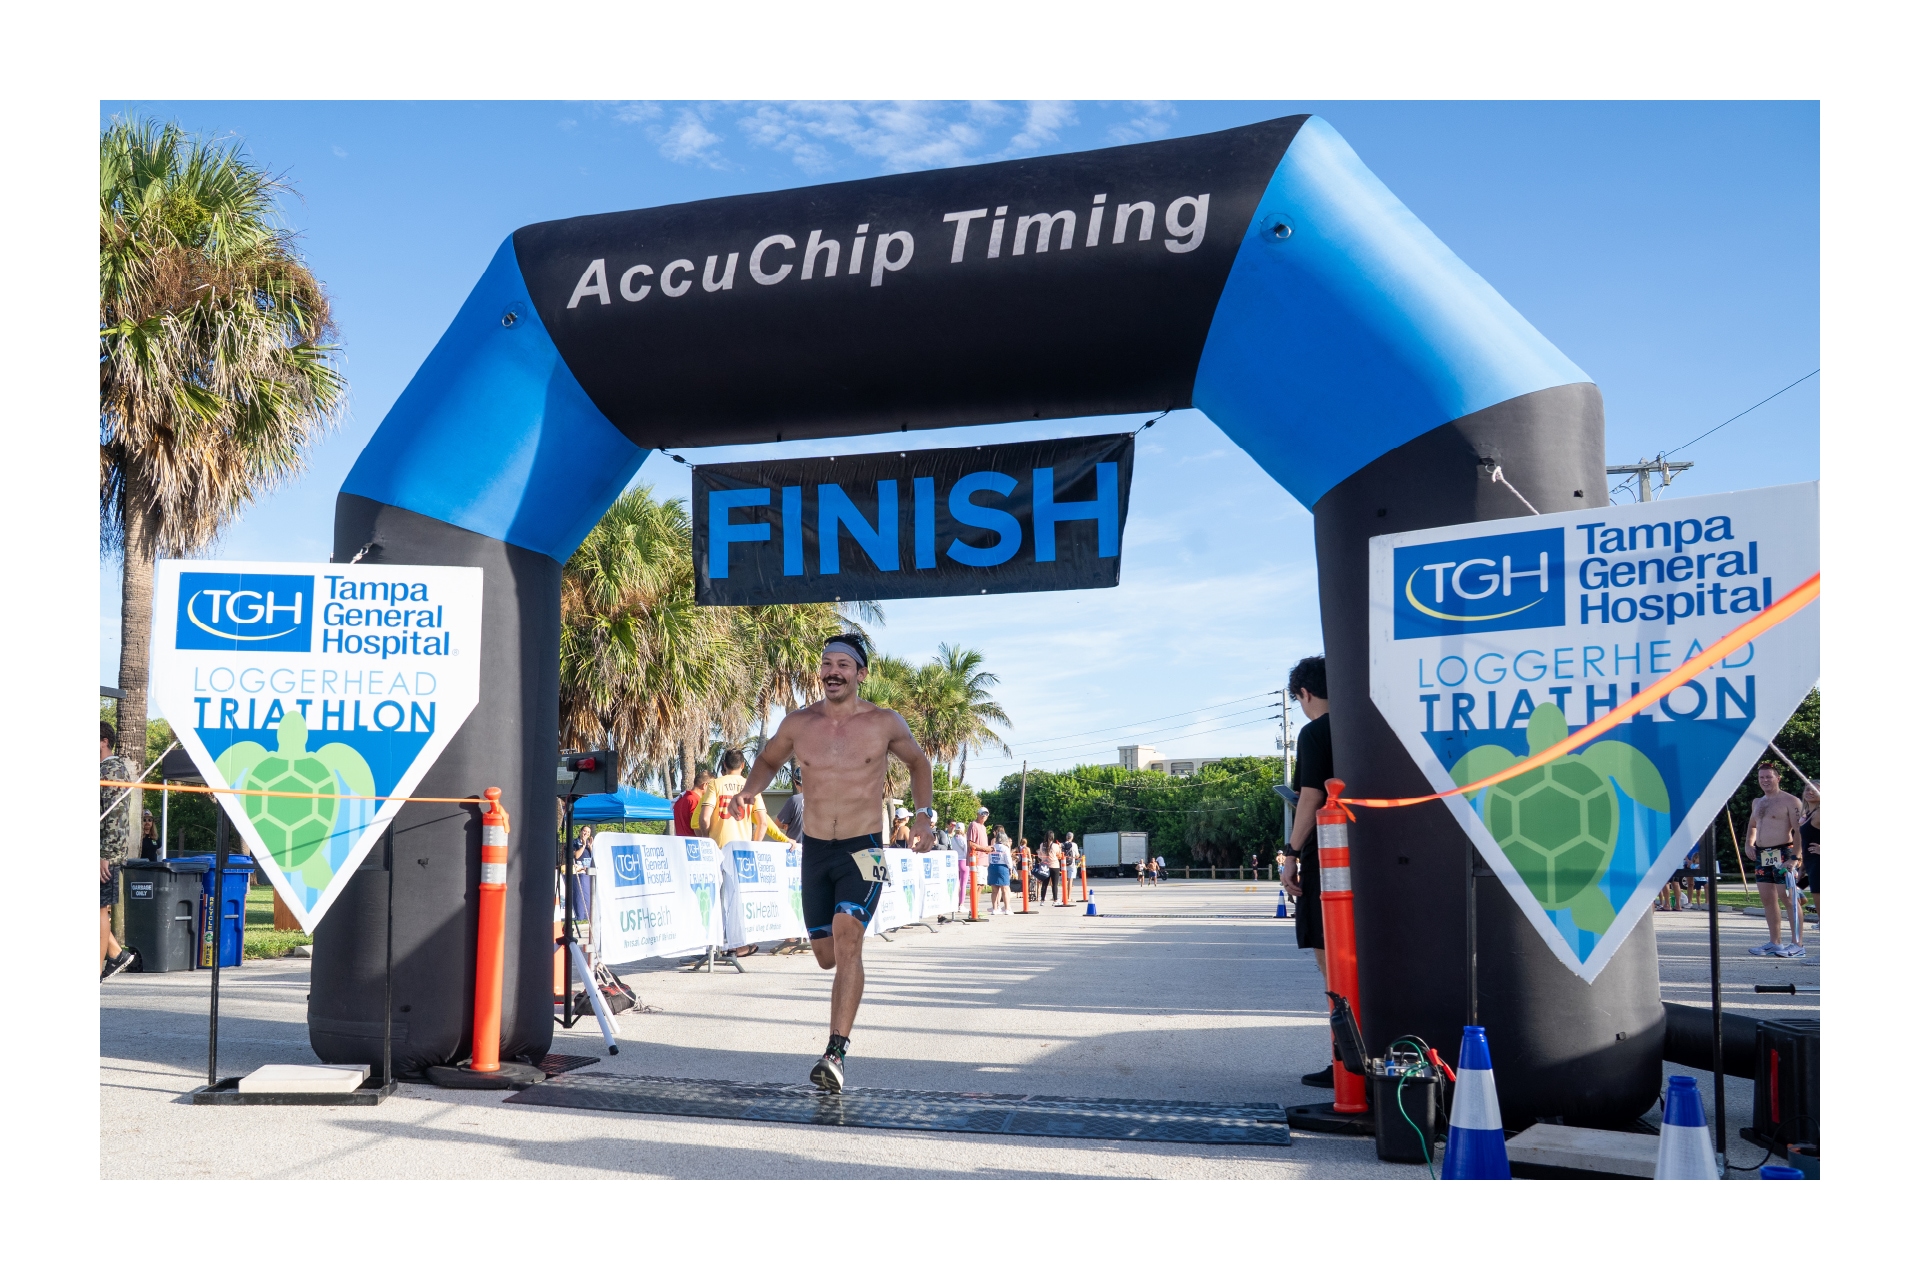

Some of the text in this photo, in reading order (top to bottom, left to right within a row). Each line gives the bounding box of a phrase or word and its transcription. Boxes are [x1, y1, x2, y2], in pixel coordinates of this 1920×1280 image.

[566, 193, 1211, 309] AccuChip Timing
[708, 461, 1119, 579] FINISH
[1577, 515, 1734, 554] Tampa
[1423, 551, 1549, 603] TGH
[1579, 541, 1758, 590] General
[324, 576, 428, 605] Tampa
[1580, 577, 1772, 625] Hospital
[203, 590, 303, 624] TGH
[323, 602, 442, 628] General
[322, 629, 449, 659] Hospital
[194, 667, 437, 695] LOGGERHEAD
[194, 697, 436, 732] TRIATHLON
[618, 854, 640, 872] TGH
[642, 845, 665, 859] Tampa
[645, 858, 669, 870] General
[737, 857, 756, 872] TGH
[647, 871, 672, 885] Hospital
